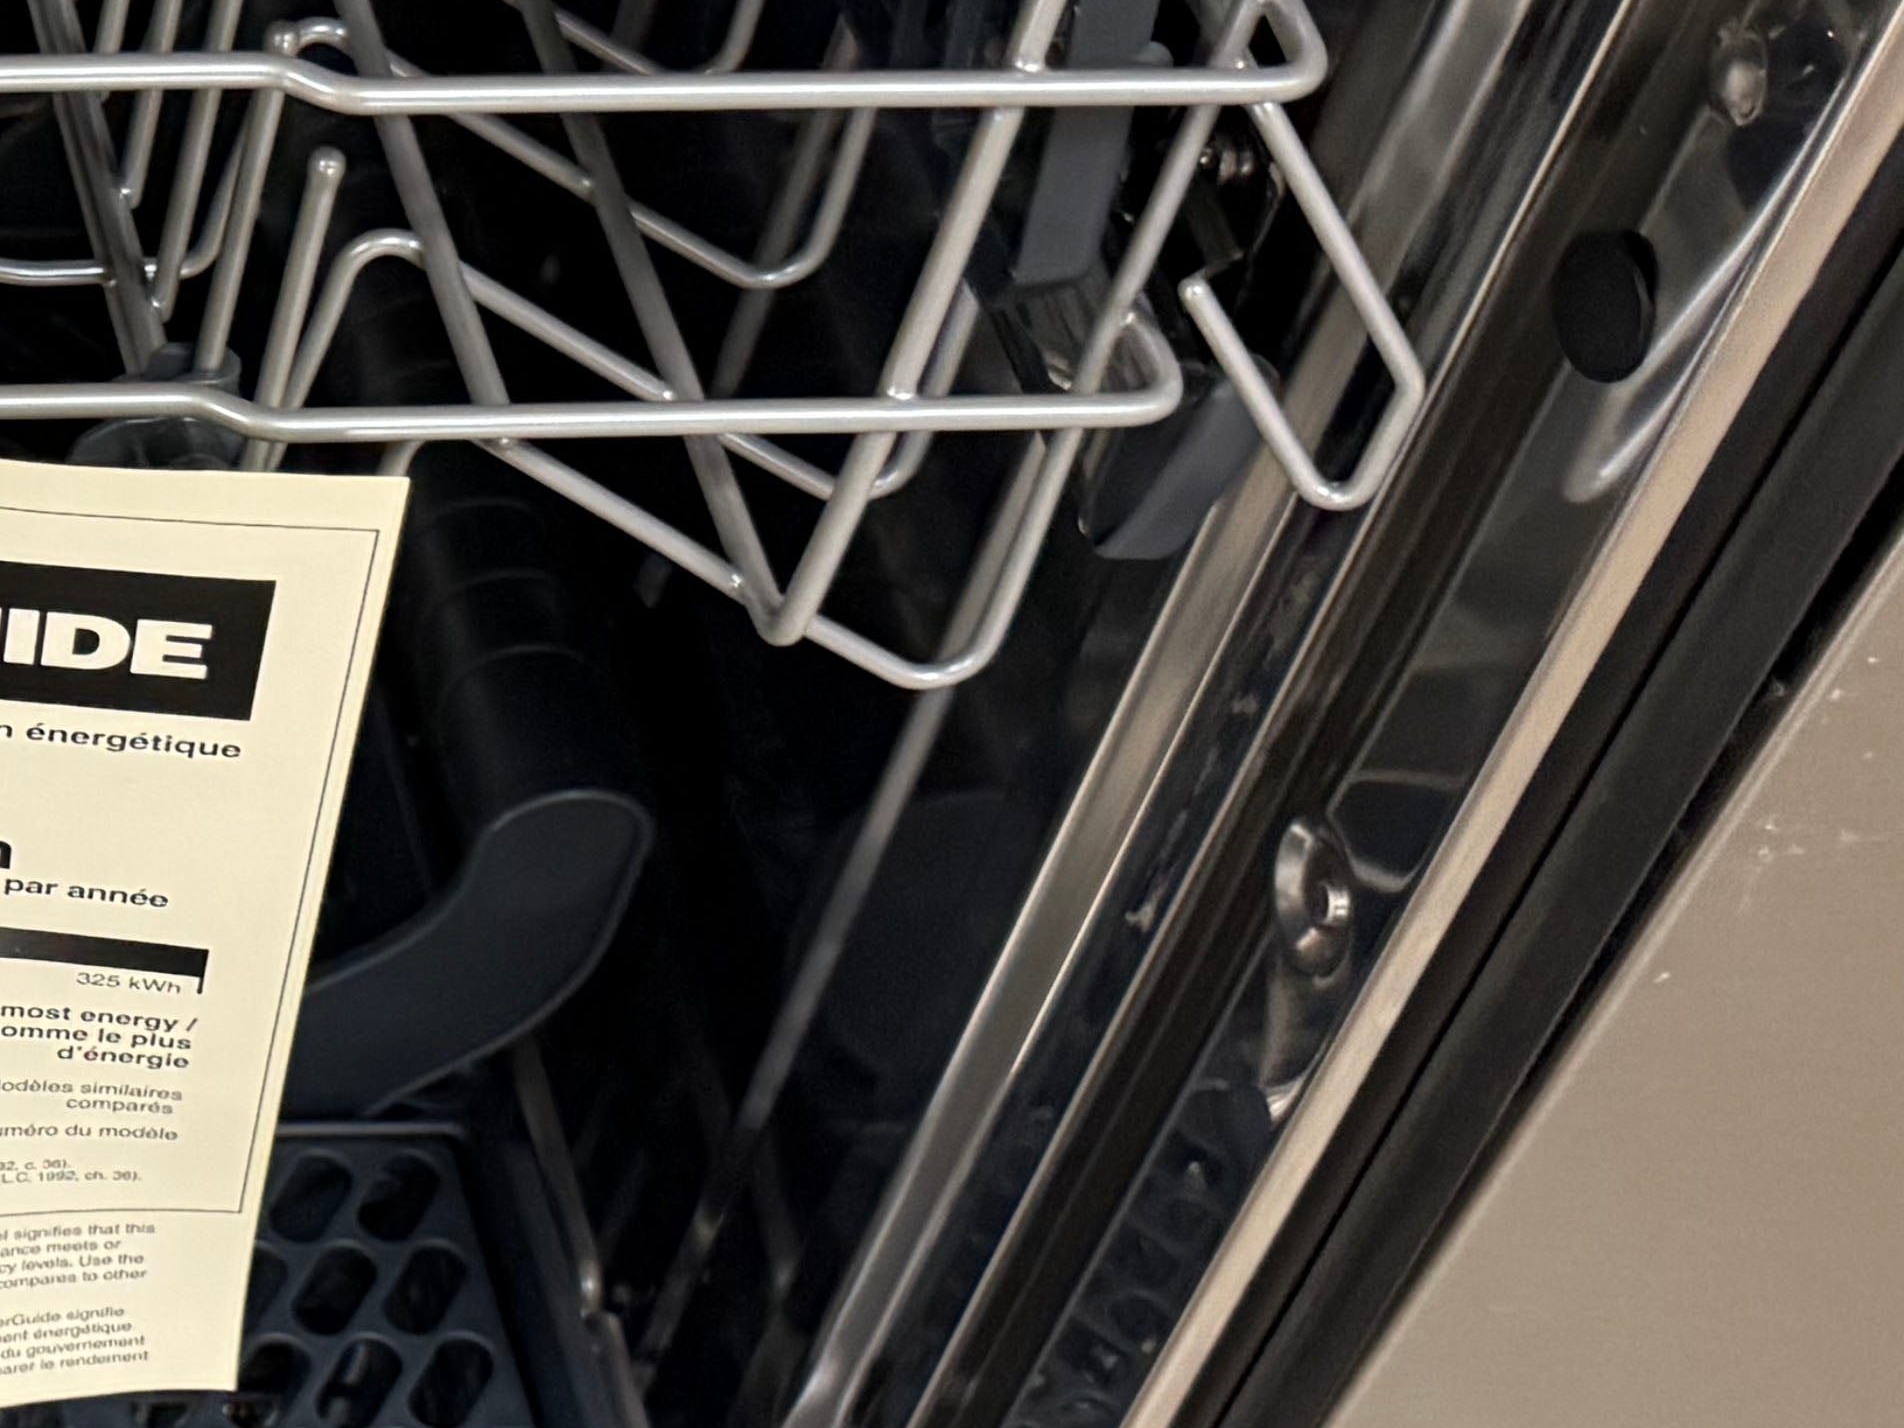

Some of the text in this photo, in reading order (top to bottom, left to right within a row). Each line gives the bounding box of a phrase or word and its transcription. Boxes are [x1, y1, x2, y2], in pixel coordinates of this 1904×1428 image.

[26, 722, 241, 759] énergétique
[4, 878, 58, 895] par
[67, 885, 168, 908] année
[76, 972, 181, 994] 325 kWh
[1, 1005, 71, 1020] most
[80, 1011, 178, 1035] energy
[186, 1017, 198, 1032] /
[98, 1028, 121, 1044] le
[130, 1028, 191, 1050] plus
[57, 1045, 189, 1070] d'énergie
[80, 1082, 182, 1101] similaires
[66, 1099, 173, 1114] comparés
[65, 1123, 91, 1136] du
[99, 1126, 178, 1141] modèle
